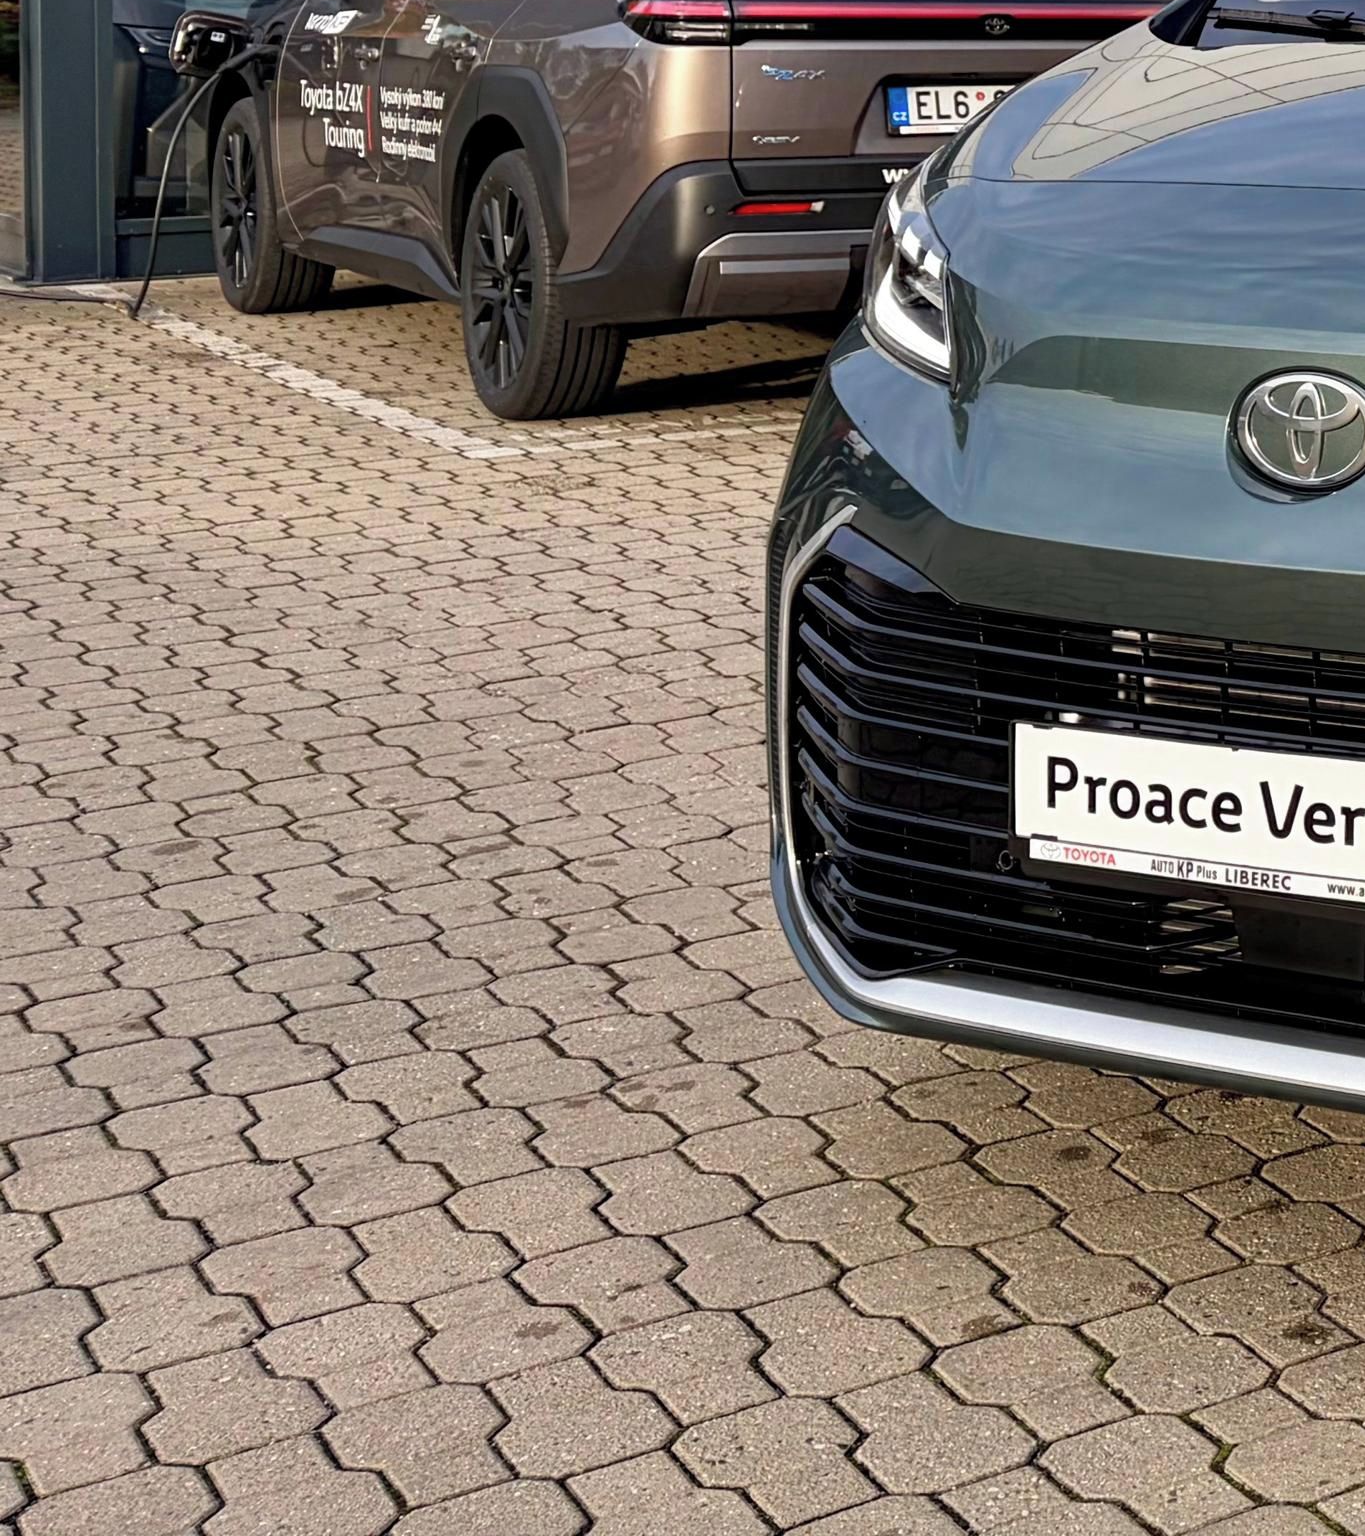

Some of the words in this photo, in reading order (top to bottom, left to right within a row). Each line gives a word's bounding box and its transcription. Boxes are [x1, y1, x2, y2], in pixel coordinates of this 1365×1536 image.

[300, 80, 334, 115] Toyota
[336, 81, 363, 113] bZ4X
[917, 91, 970, 120] EL6
[893, 112, 907, 121] CZ
[323, 118, 365, 157] Touring
[1047, 755, 1242, 833] Proace
[1062, 847, 1117, 867] TOYOTA
[1151, 858, 1174, 874] AUTO
[1177, 860, 1194, 880] KP
[1196, 864, 1217, 881] Plus
[1224, 868, 1292, 892] LIBEREC
